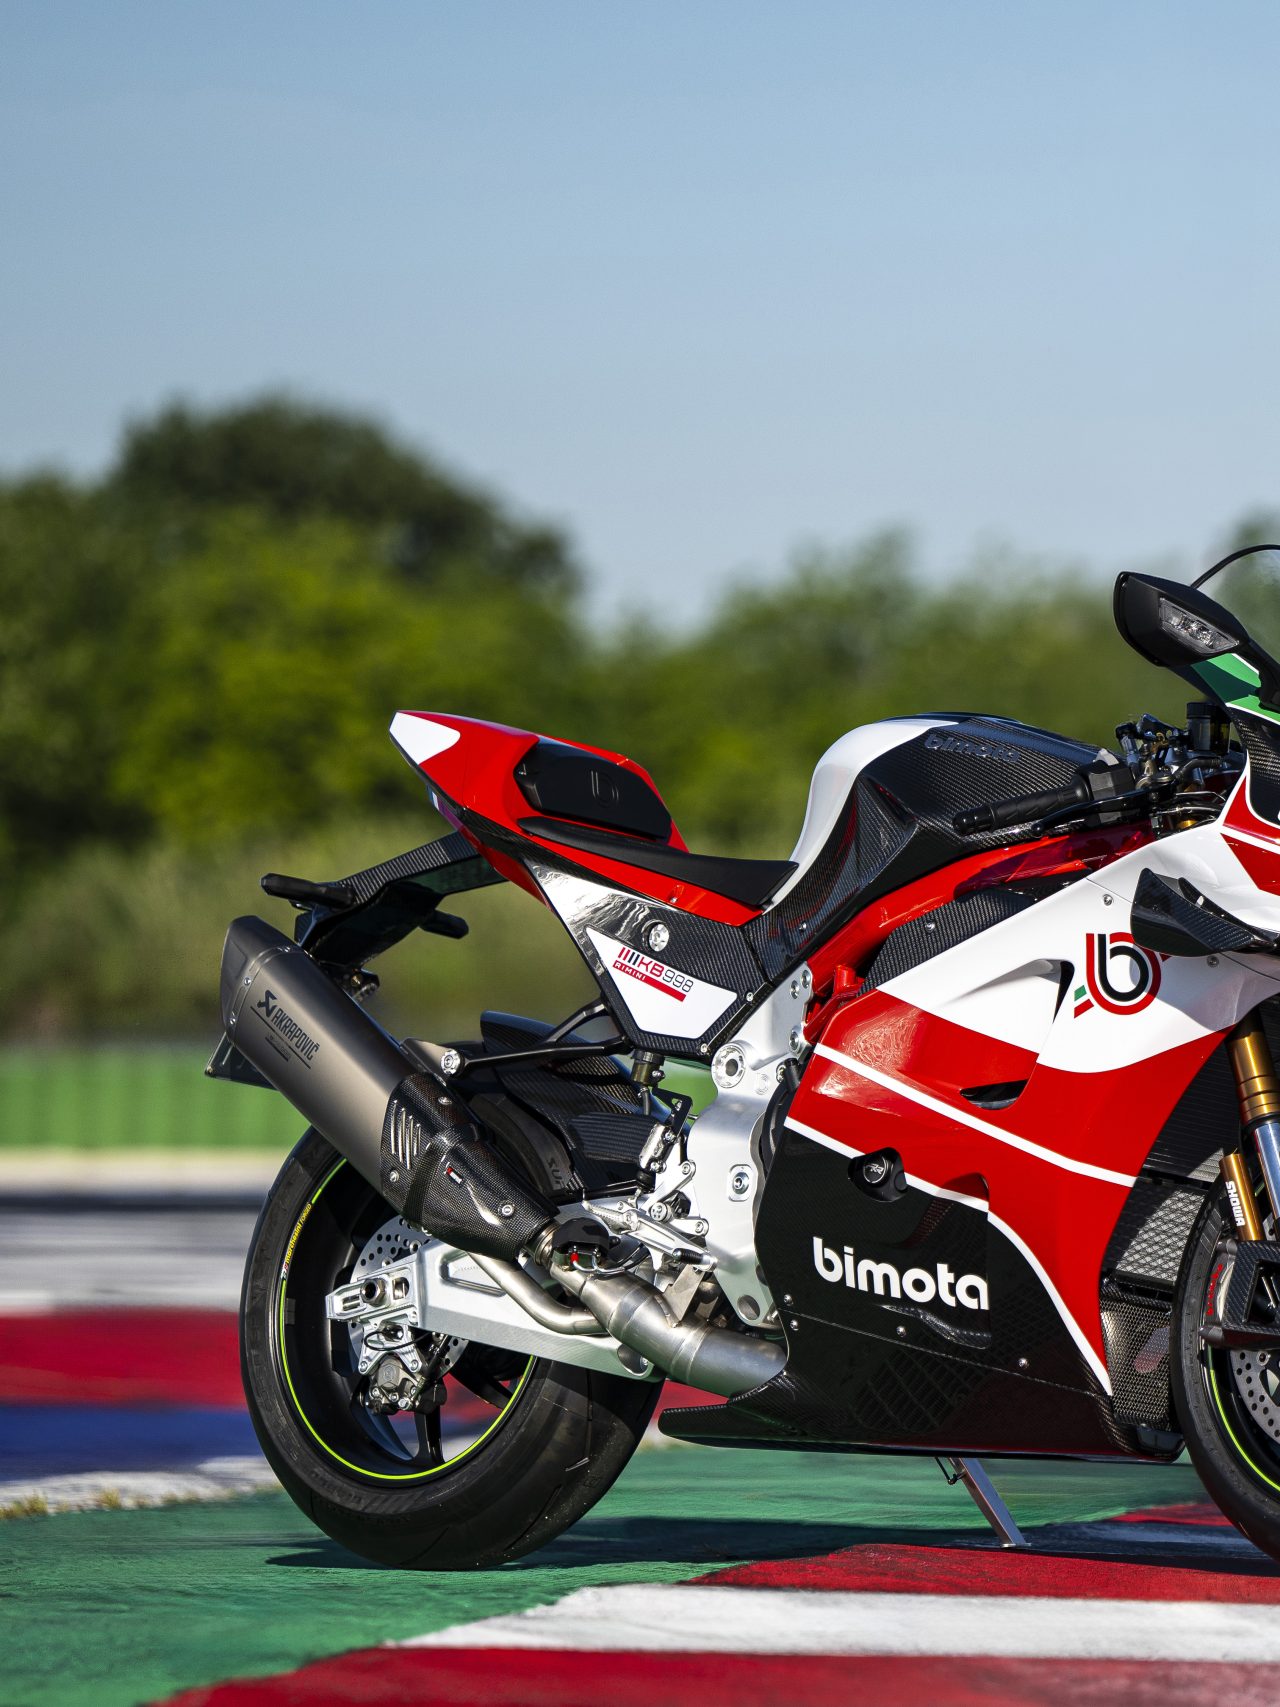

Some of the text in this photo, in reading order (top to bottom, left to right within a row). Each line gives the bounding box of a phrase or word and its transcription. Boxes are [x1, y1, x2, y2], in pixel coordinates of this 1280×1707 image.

[925, 733, 1021, 763] bimota
[614, 961, 647, 982] RIMINI
[1225, 1180, 1246, 1227] SHOWA
[812, 1236, 989, 1311] bimota
